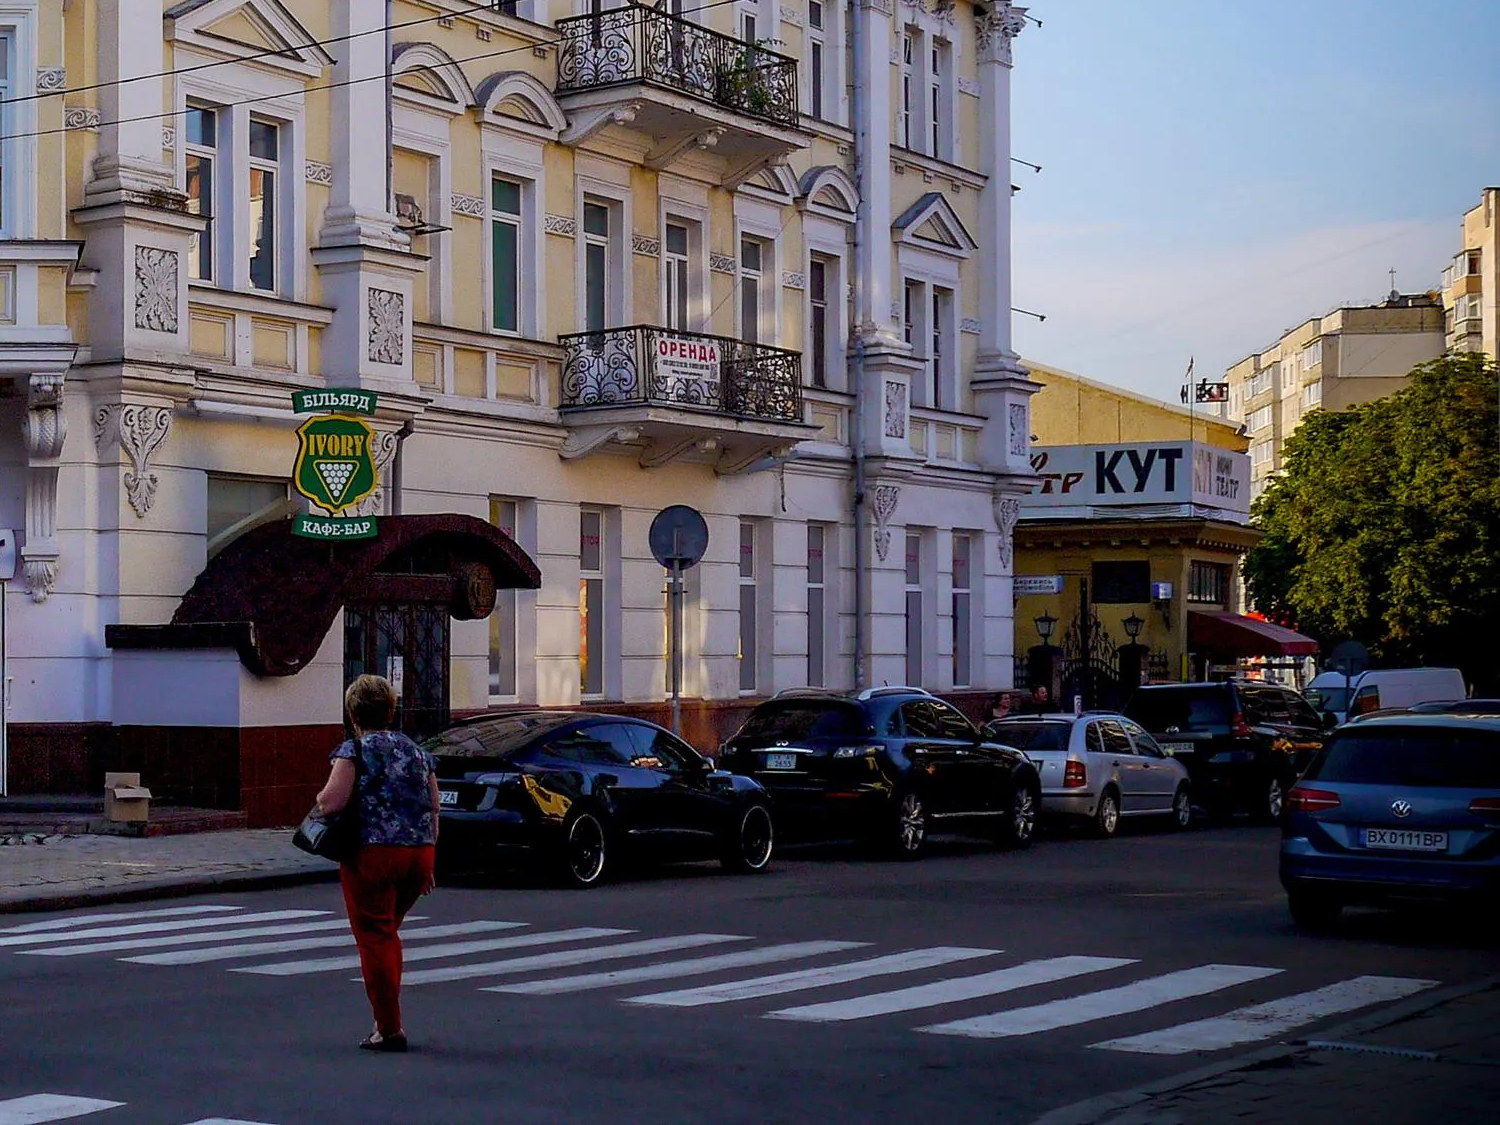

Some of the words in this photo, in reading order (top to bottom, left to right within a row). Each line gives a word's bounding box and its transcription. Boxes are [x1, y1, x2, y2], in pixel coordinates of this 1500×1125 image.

[659, 340, 717, 363] ОРЕНДА
[302, 393, 370, 411] БІЛЬЯРД
[308, 434, 365, 457] IVORY
[1096, 448, 1183, 494] КУТ
[302, 521, 371, 536] КАФЕ-БАР
[1389, 831, 1421, 846] 0111
